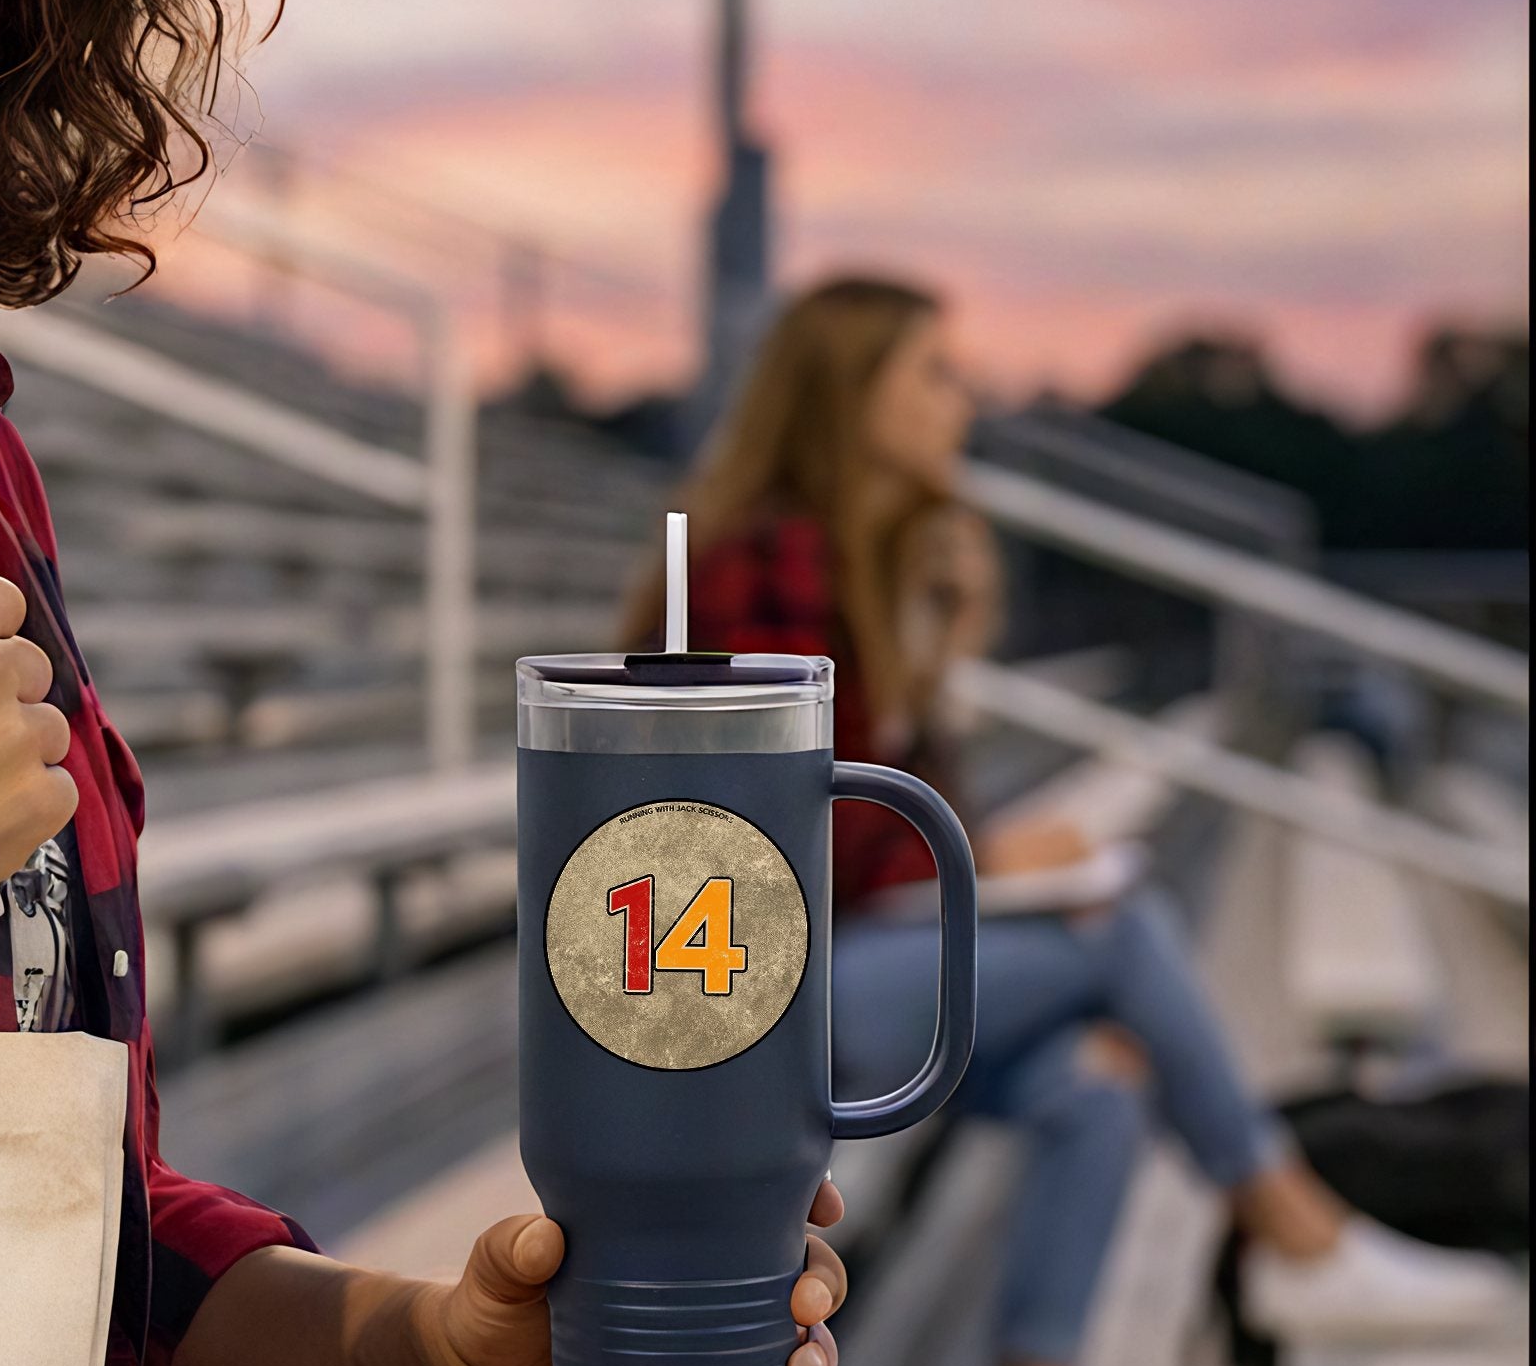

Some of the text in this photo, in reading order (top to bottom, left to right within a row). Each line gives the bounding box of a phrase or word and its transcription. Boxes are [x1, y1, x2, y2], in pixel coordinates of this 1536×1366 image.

[619, 807, 654, 825] RUNNING
[655, 805, 675, 813] WITH
[677, 805, 697, 813] JACK
[607, 874, 748, 996] 14
